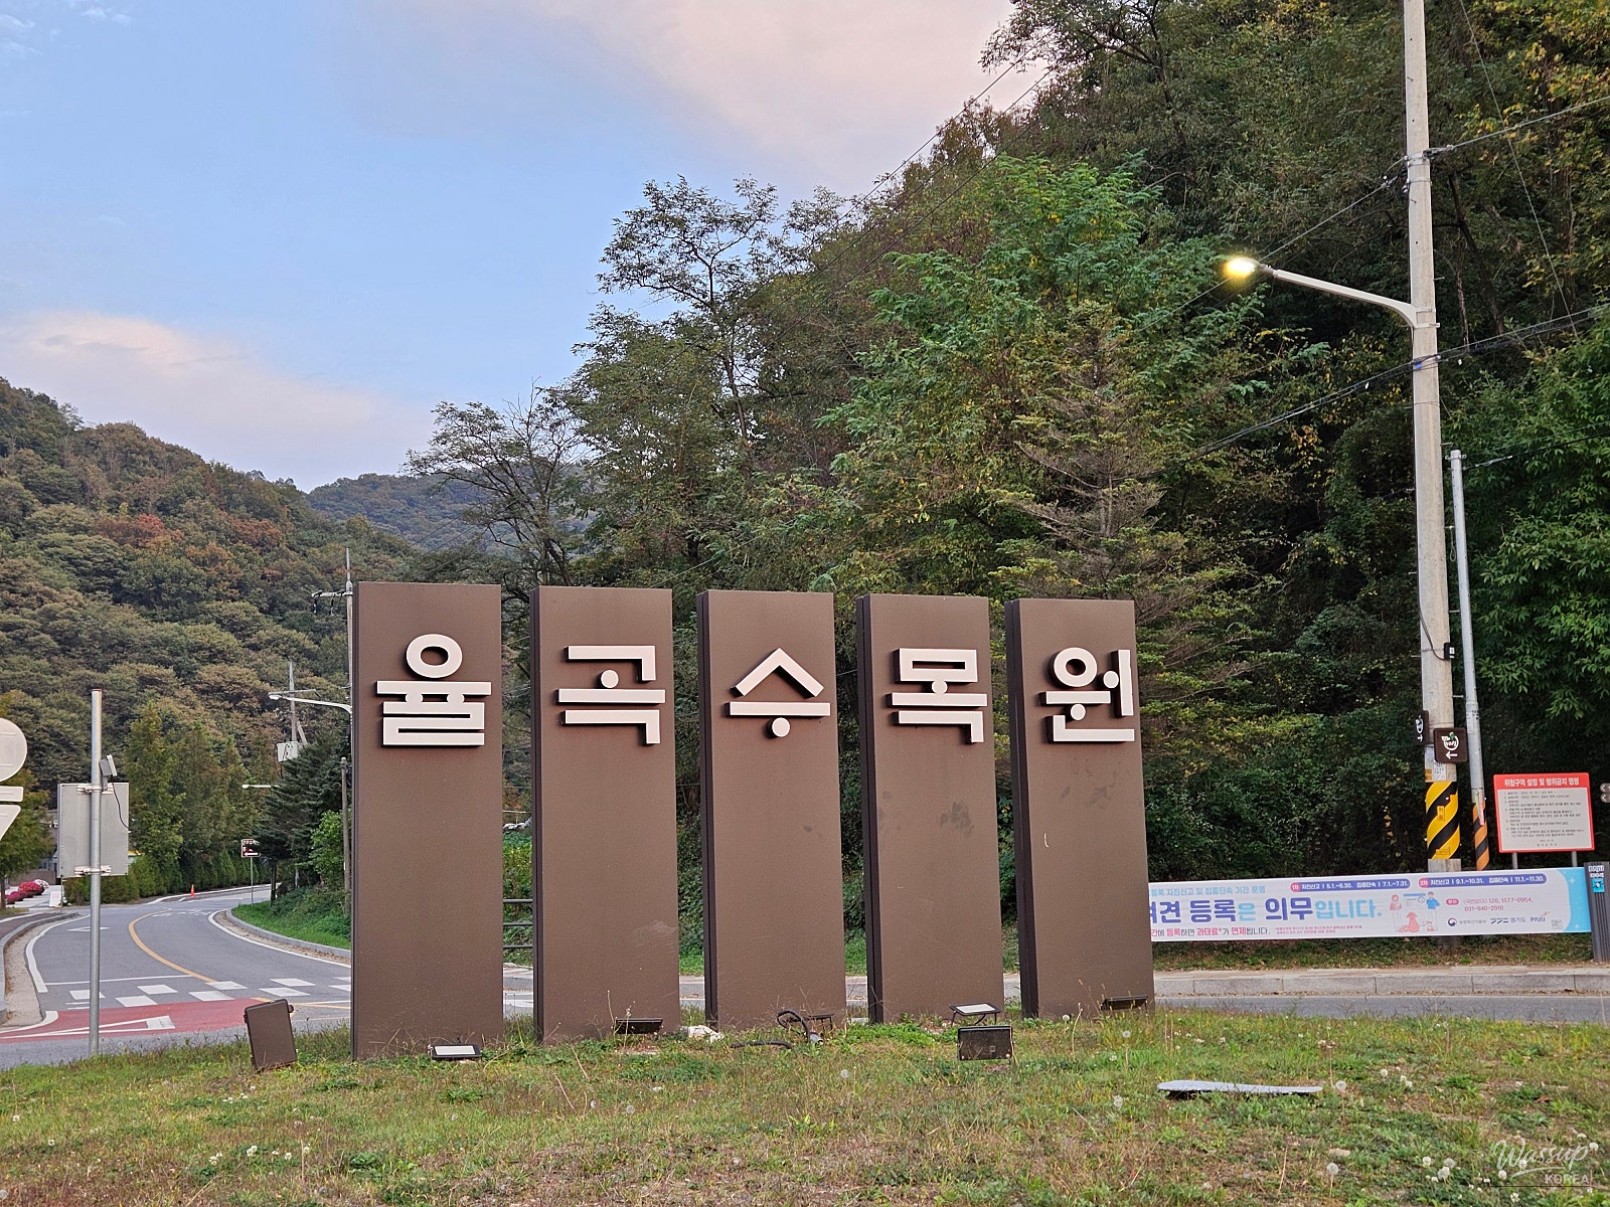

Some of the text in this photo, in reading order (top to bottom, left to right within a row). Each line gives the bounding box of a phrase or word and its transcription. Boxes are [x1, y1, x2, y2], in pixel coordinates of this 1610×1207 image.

[376, 633, 1136, 748] 율 곡 수 목 원
[1189, 899, 1257, 923] 등록은
[1265, 897, 1382, 921] 의무입니다.
